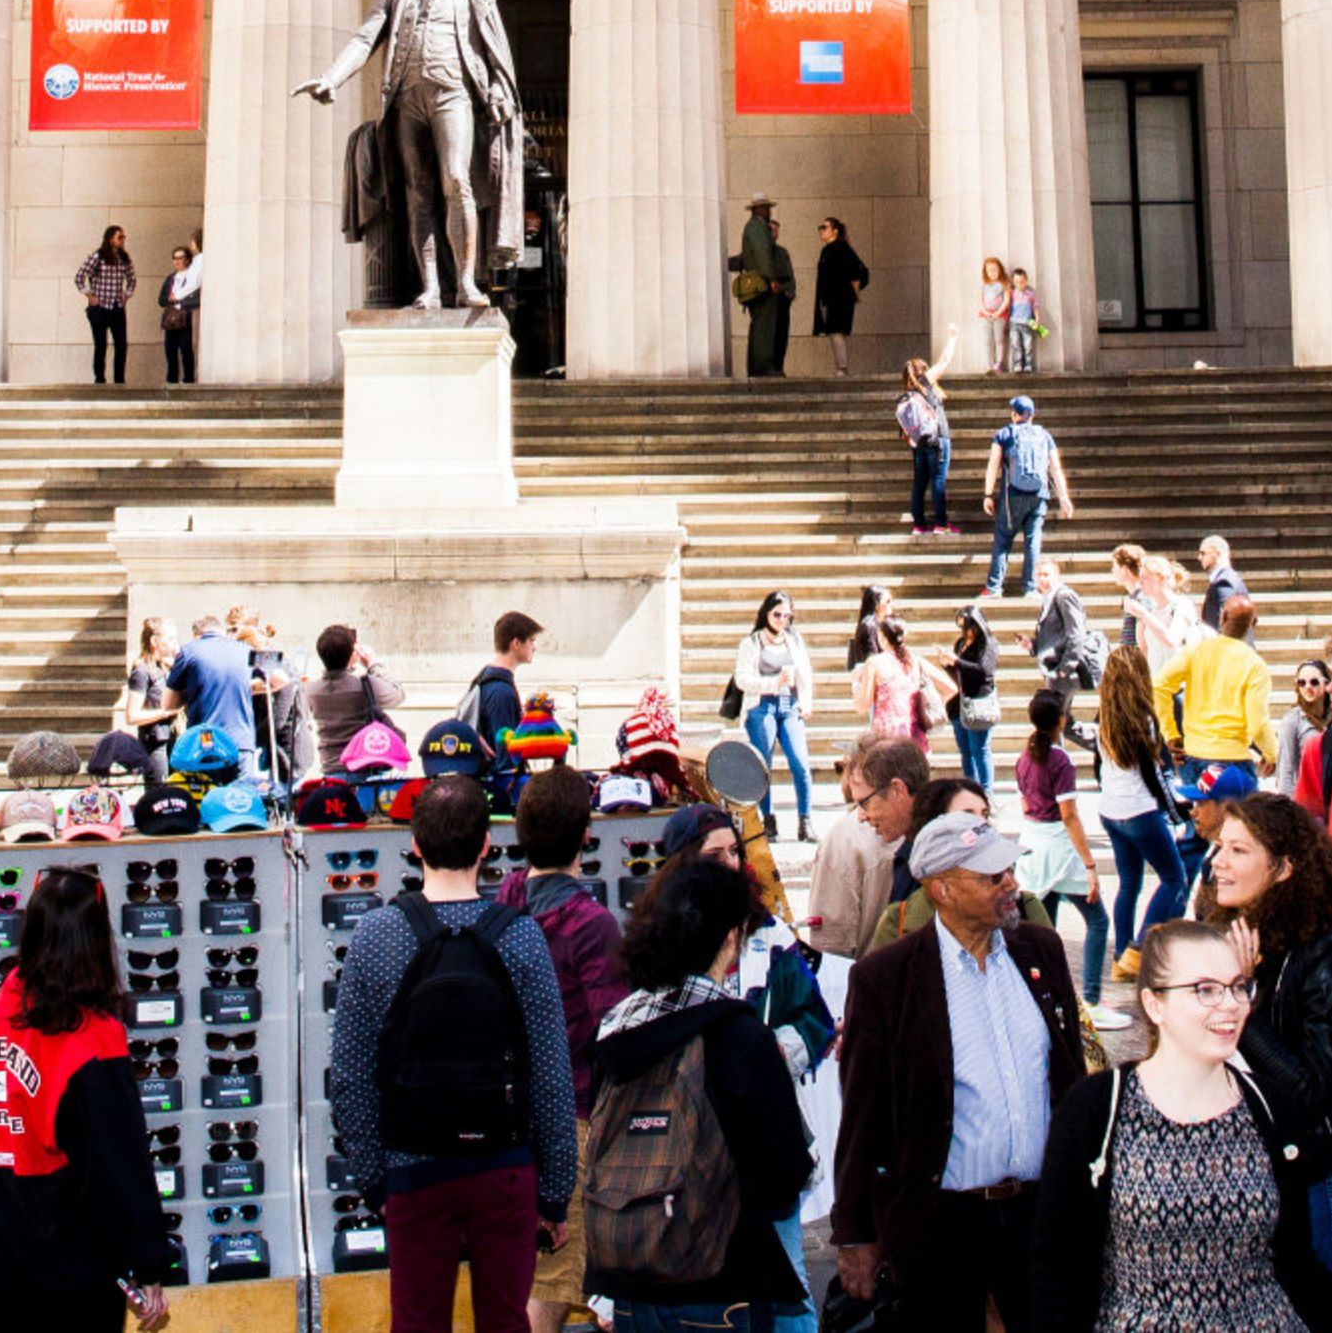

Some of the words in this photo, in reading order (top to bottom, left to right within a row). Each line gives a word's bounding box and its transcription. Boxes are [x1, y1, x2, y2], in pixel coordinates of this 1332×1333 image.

[769, 0, 851, 14] SUPPORTED
[855, 0, 873, 13] BY
[67, 19, 147, 34] SUPPORTED
[150, 19, 169, 34] BY
[84, 72, 124, 81] National
[84, 82, 120, 91] Historic
[325, 797, 347, 818] NY
